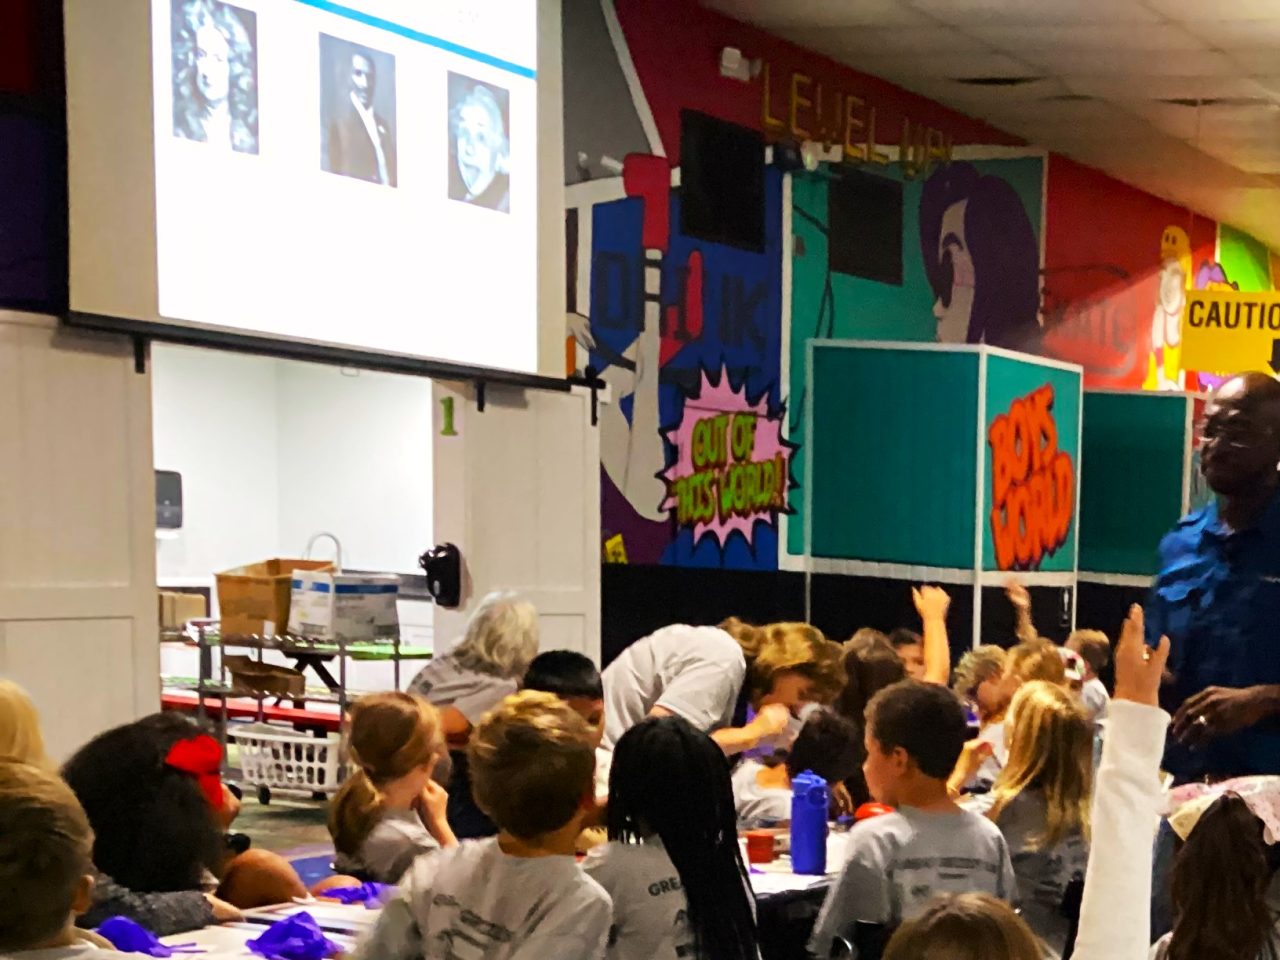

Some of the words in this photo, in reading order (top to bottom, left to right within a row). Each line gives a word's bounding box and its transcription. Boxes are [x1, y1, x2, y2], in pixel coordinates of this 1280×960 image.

[440, 396, 458, 436] 1
[692, 415, 729, 471] OUT
[731, 411, 757, 463] OF
[668, 470, 715, 526] THIS
[648, 877, 683, 896] GRE
